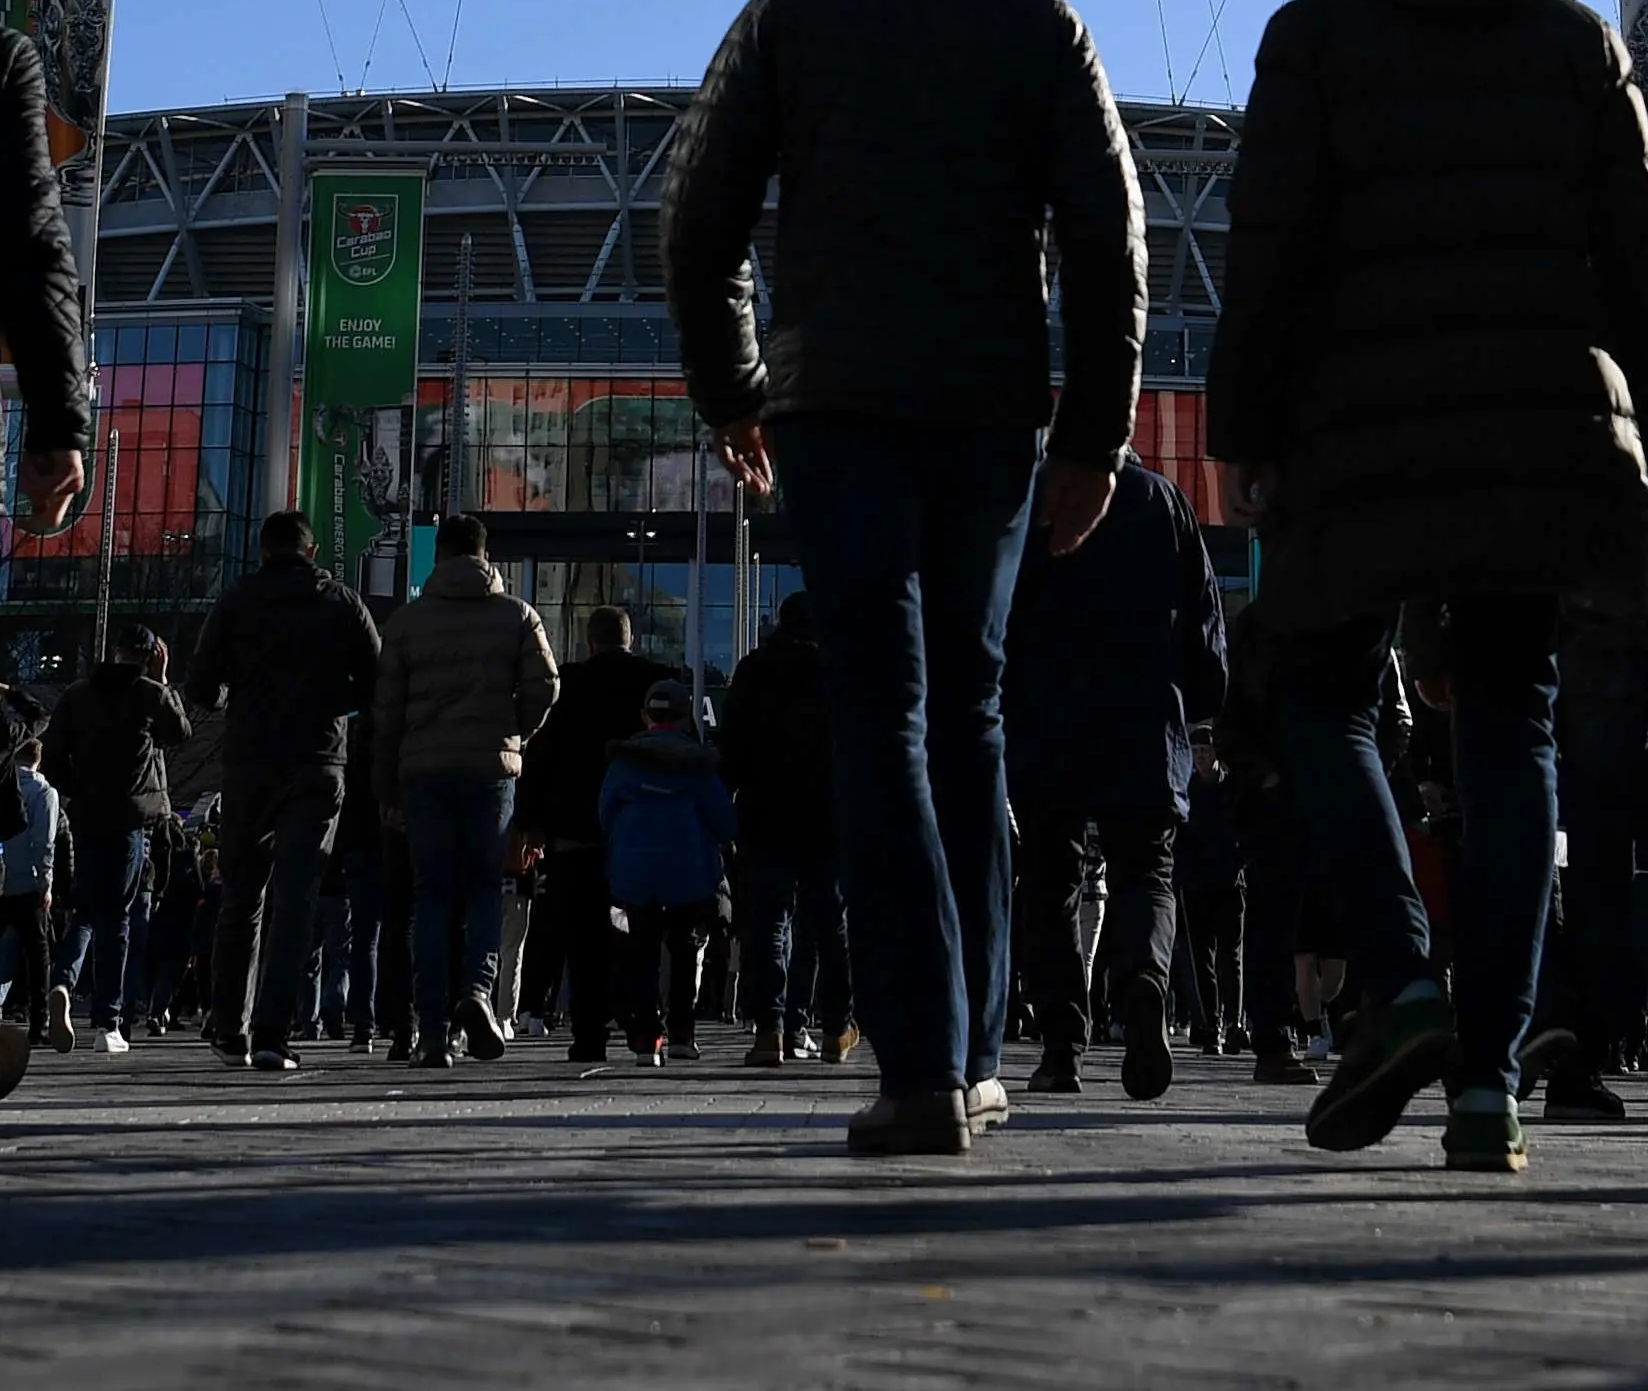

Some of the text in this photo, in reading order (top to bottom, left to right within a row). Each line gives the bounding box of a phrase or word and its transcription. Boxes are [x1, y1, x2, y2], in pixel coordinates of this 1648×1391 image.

[336, 230, 392, 248] Carabao
[351, 245, 377, 257] Cup
[362, 267, 377, 276] EFL
[339, 318, 383, 332] ENJOY
[324, 336, 396, 349] THE GAME!
[334, 453, 345, 513] Carabao
[334, 516, 345, 561] ENERGY
